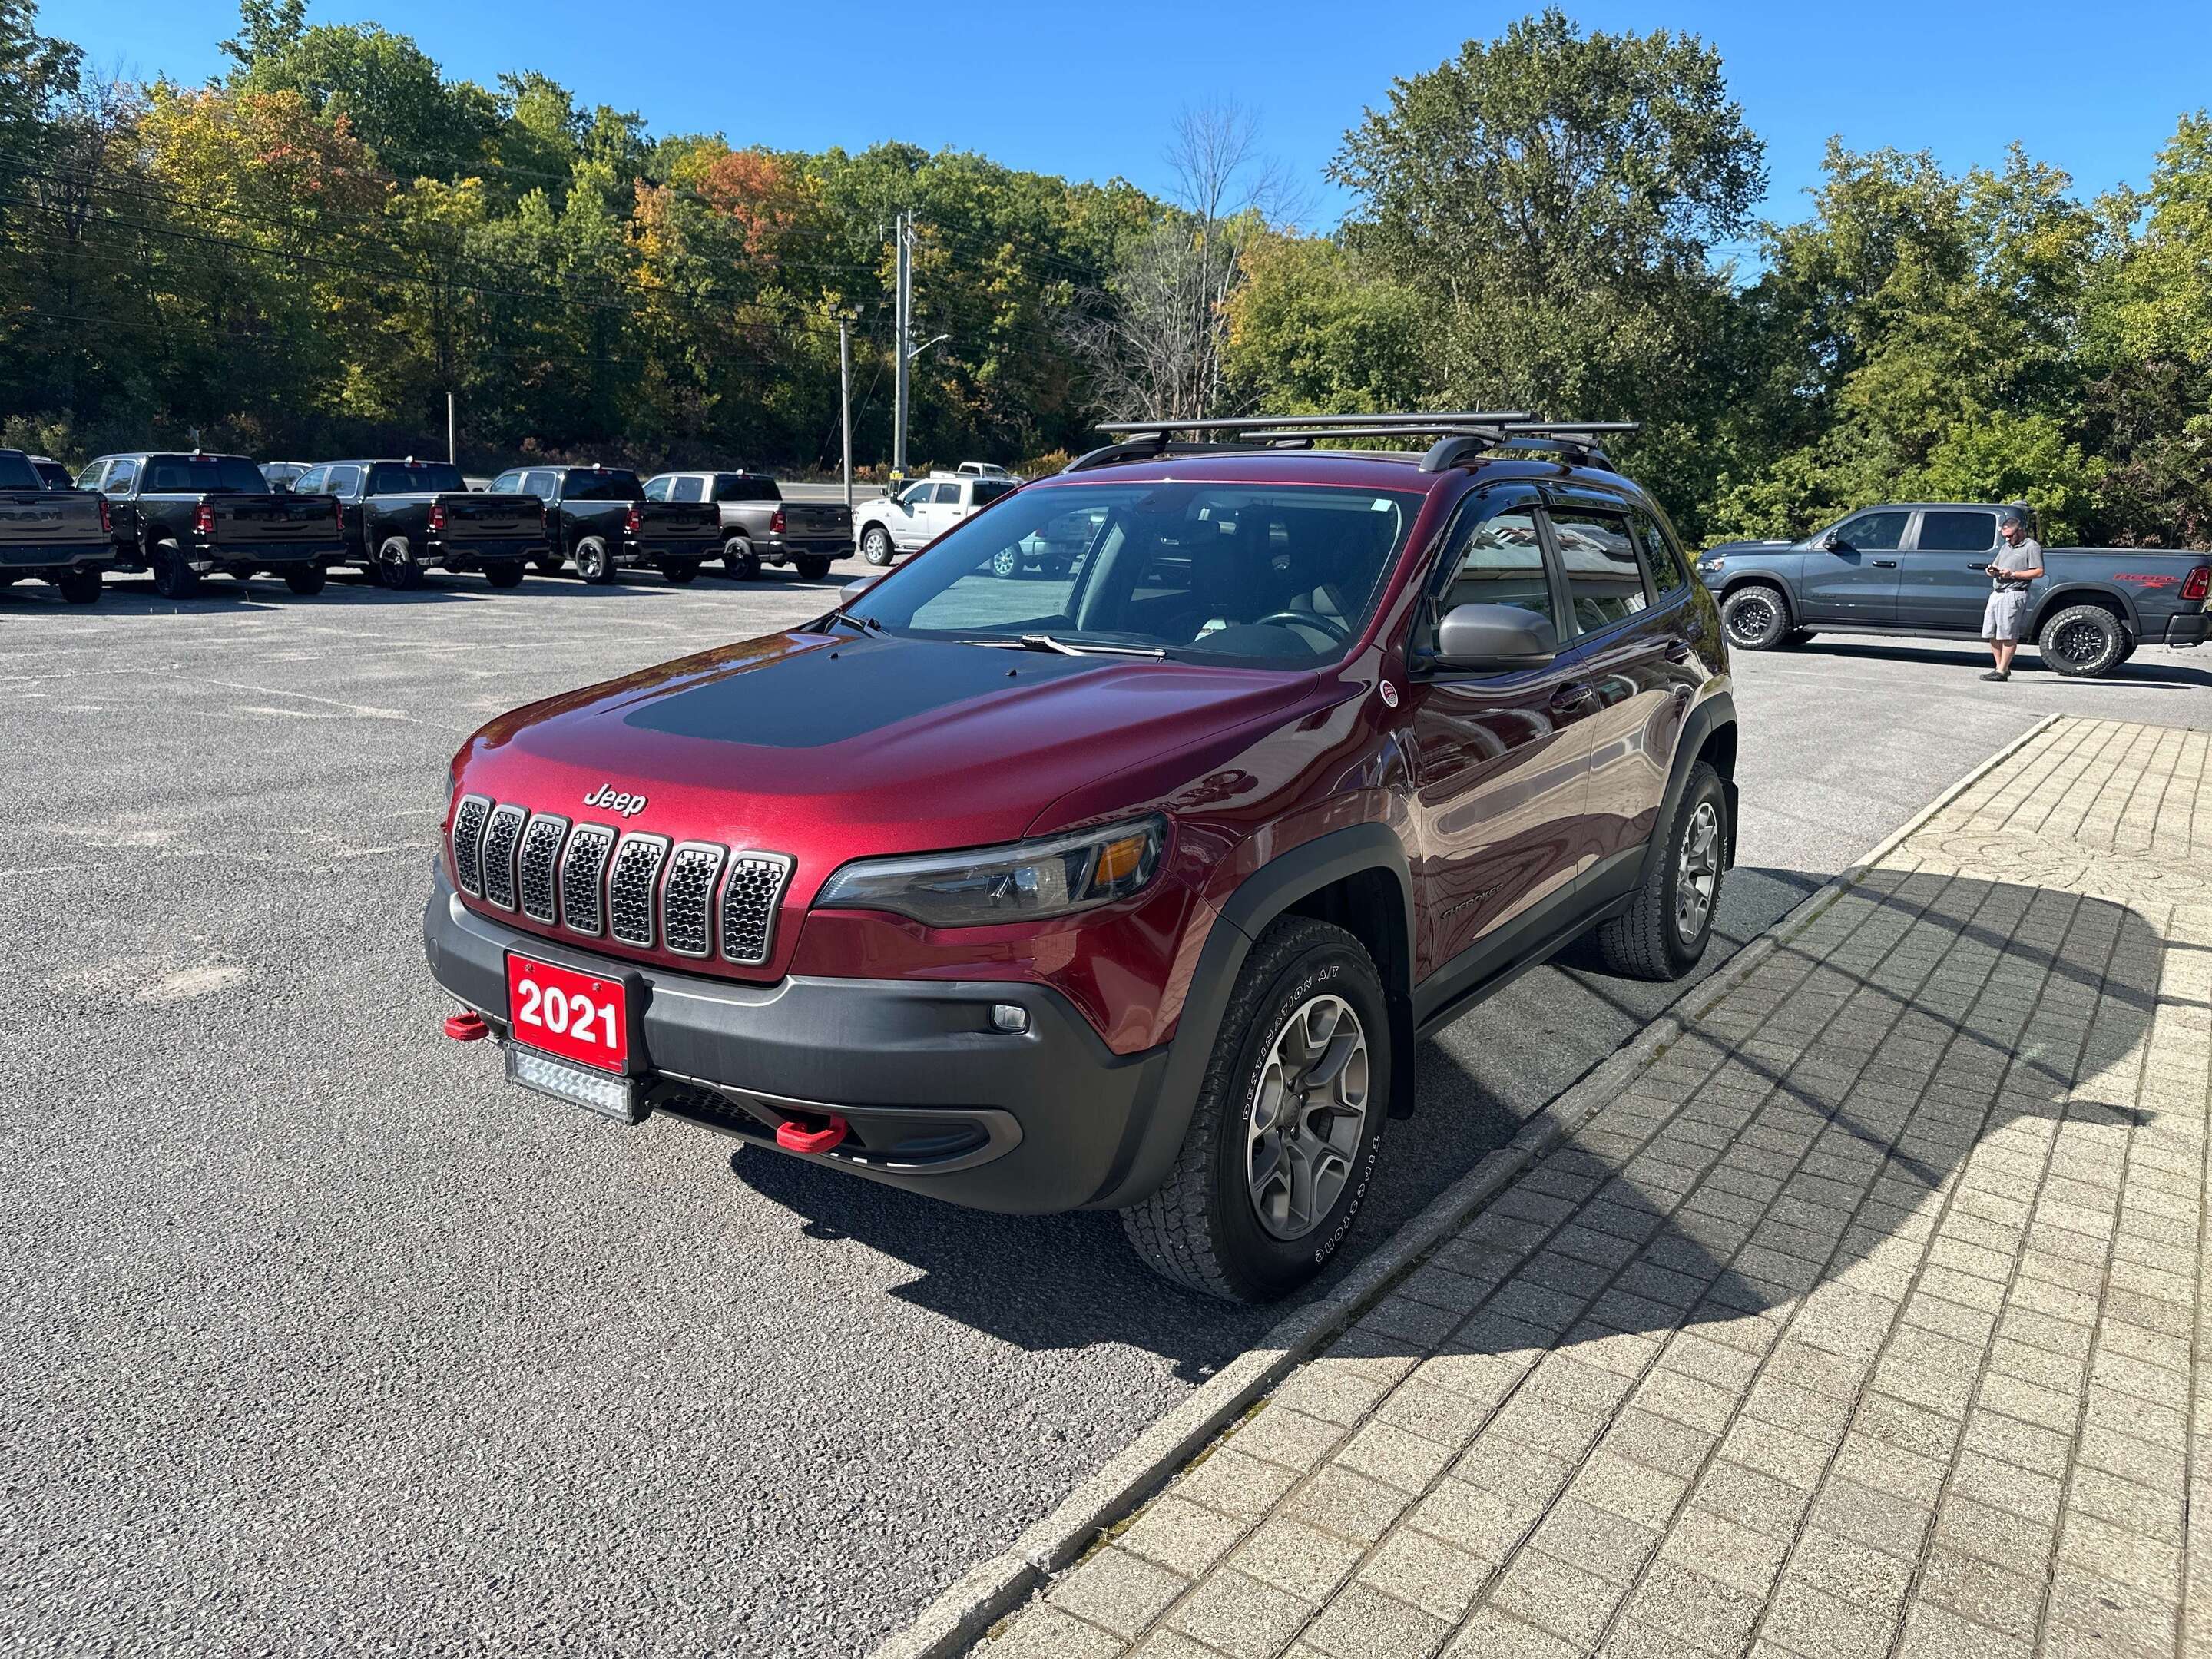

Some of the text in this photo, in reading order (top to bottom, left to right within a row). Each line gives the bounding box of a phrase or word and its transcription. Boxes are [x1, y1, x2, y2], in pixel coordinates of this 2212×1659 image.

[583, 783, 648, 819] Jeep
[1439, 882, 1505, 920] CHEROKEE
[517, 978, 618, 1049] 2021
[1242, 965, 1340, 1121] DESTINATION A/T
